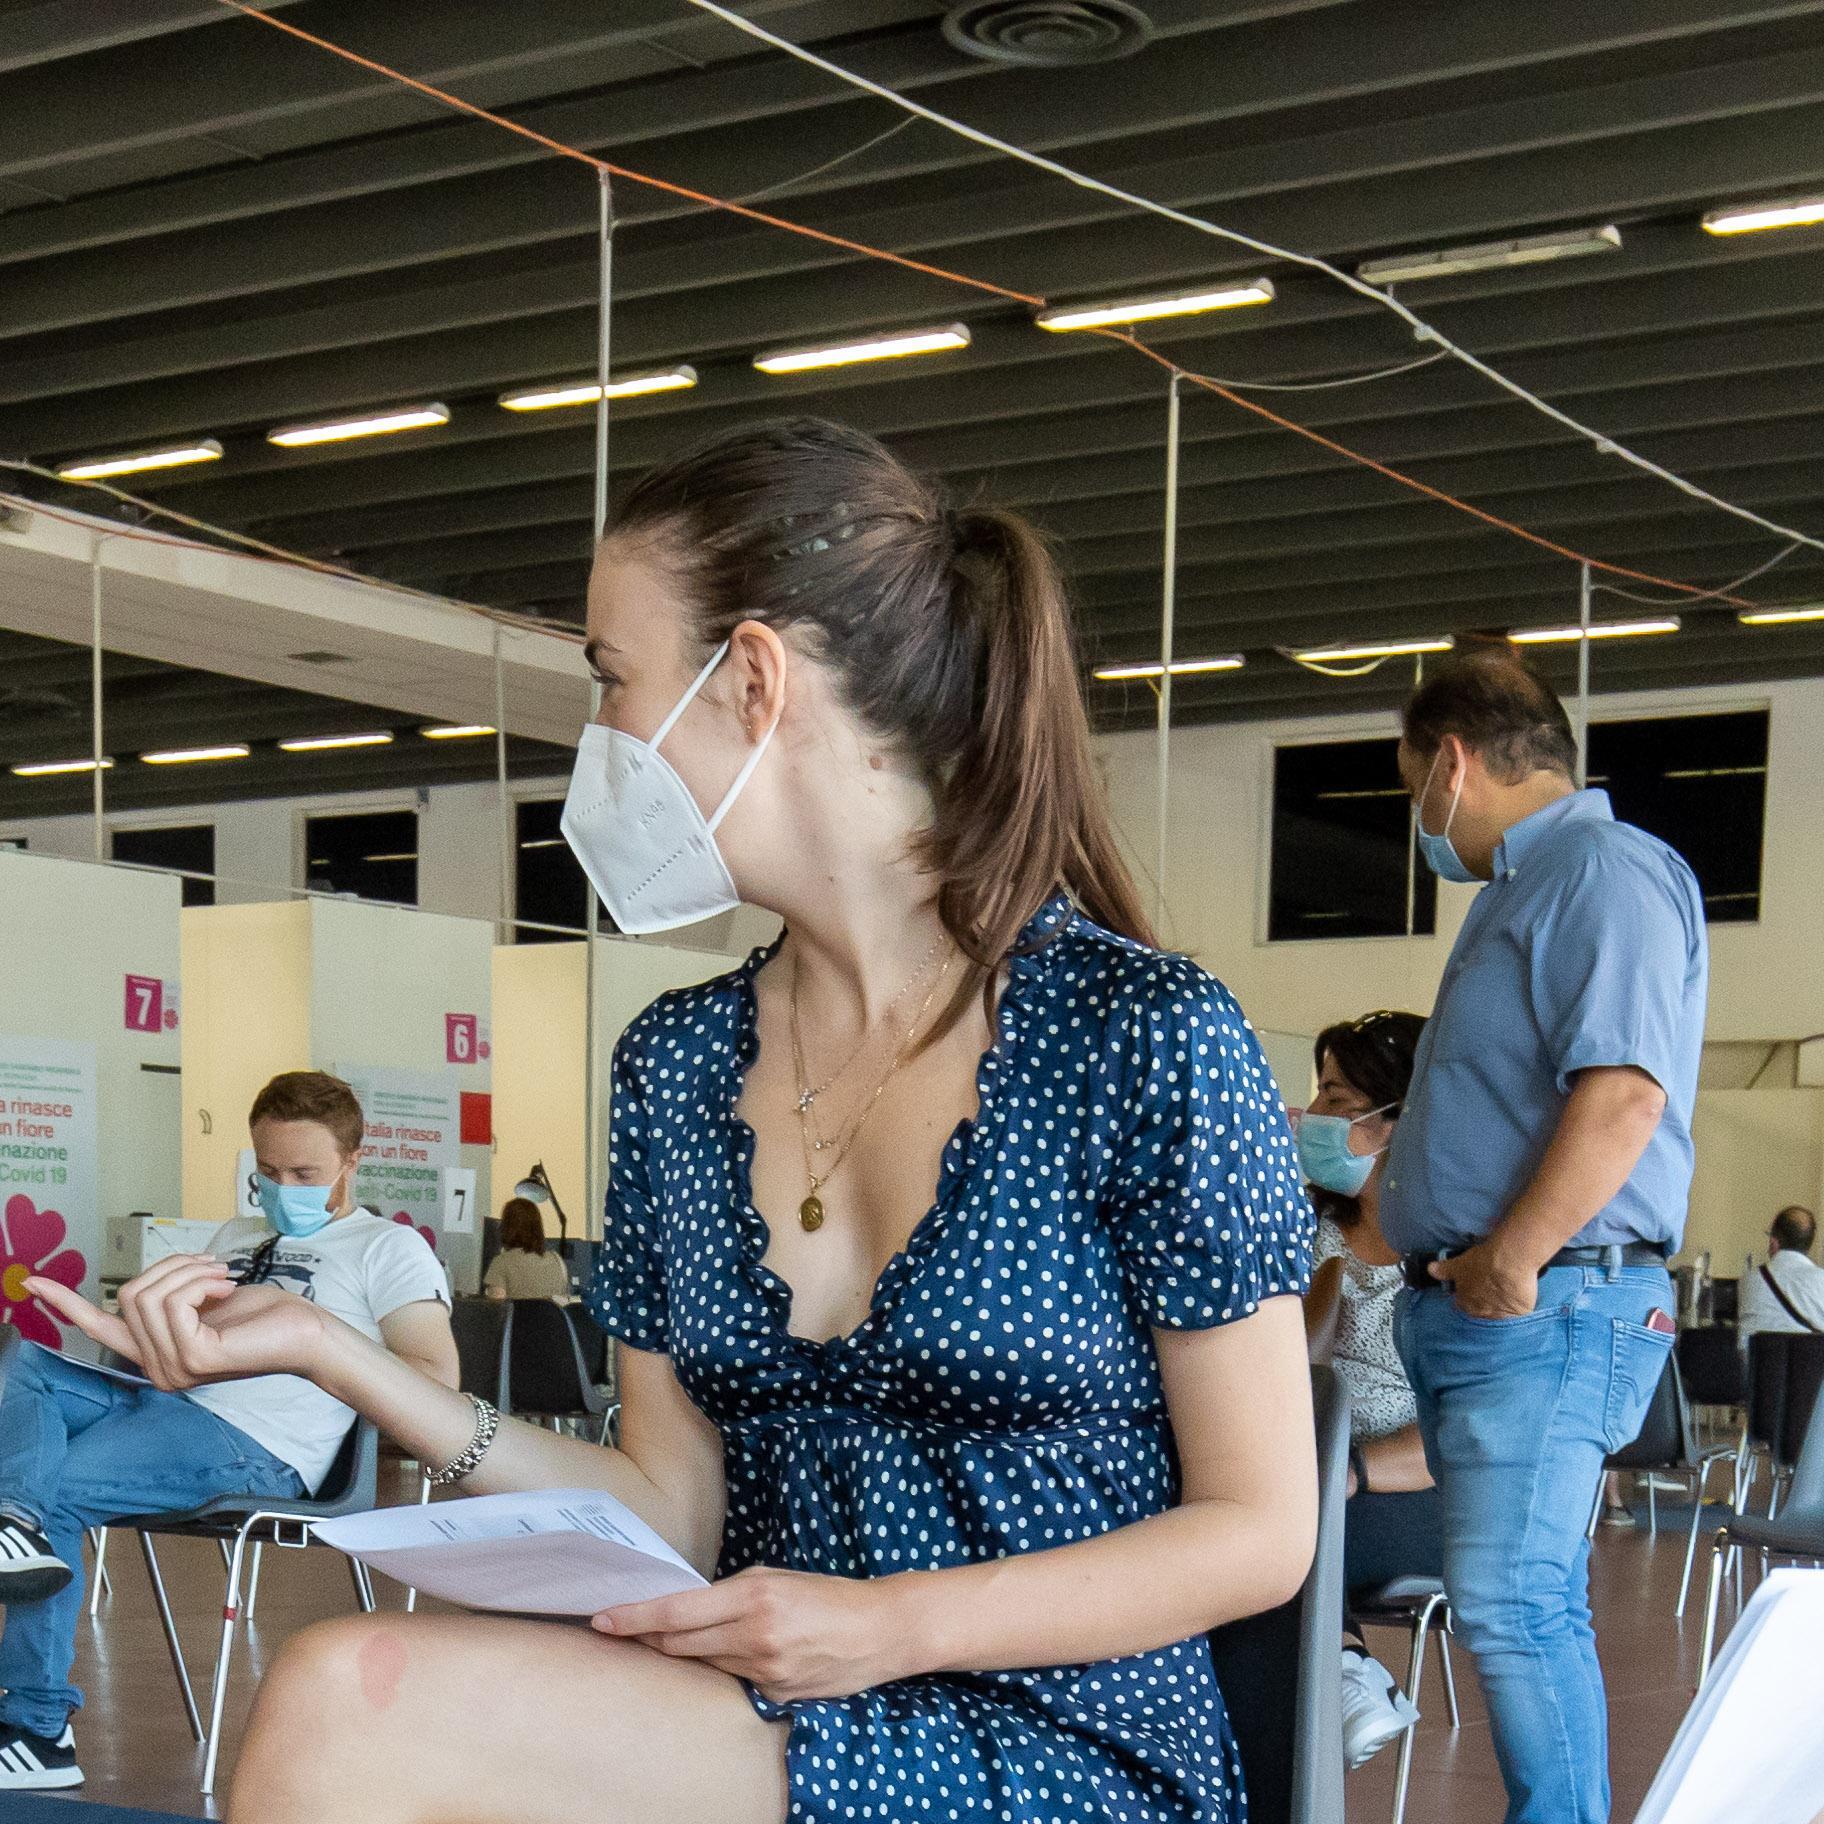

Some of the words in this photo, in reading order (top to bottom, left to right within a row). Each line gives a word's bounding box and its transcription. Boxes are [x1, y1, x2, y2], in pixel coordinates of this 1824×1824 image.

[135, 987, 152, 1026] 7
[454, 1023, 470, 1058] 6
[10, 1096, 73, 1118] rinasce
[16, 1118, 54, 1139] fiore
[49, 1166, 68, 1185] 19
[453, 1188, 467, 1222] 7
